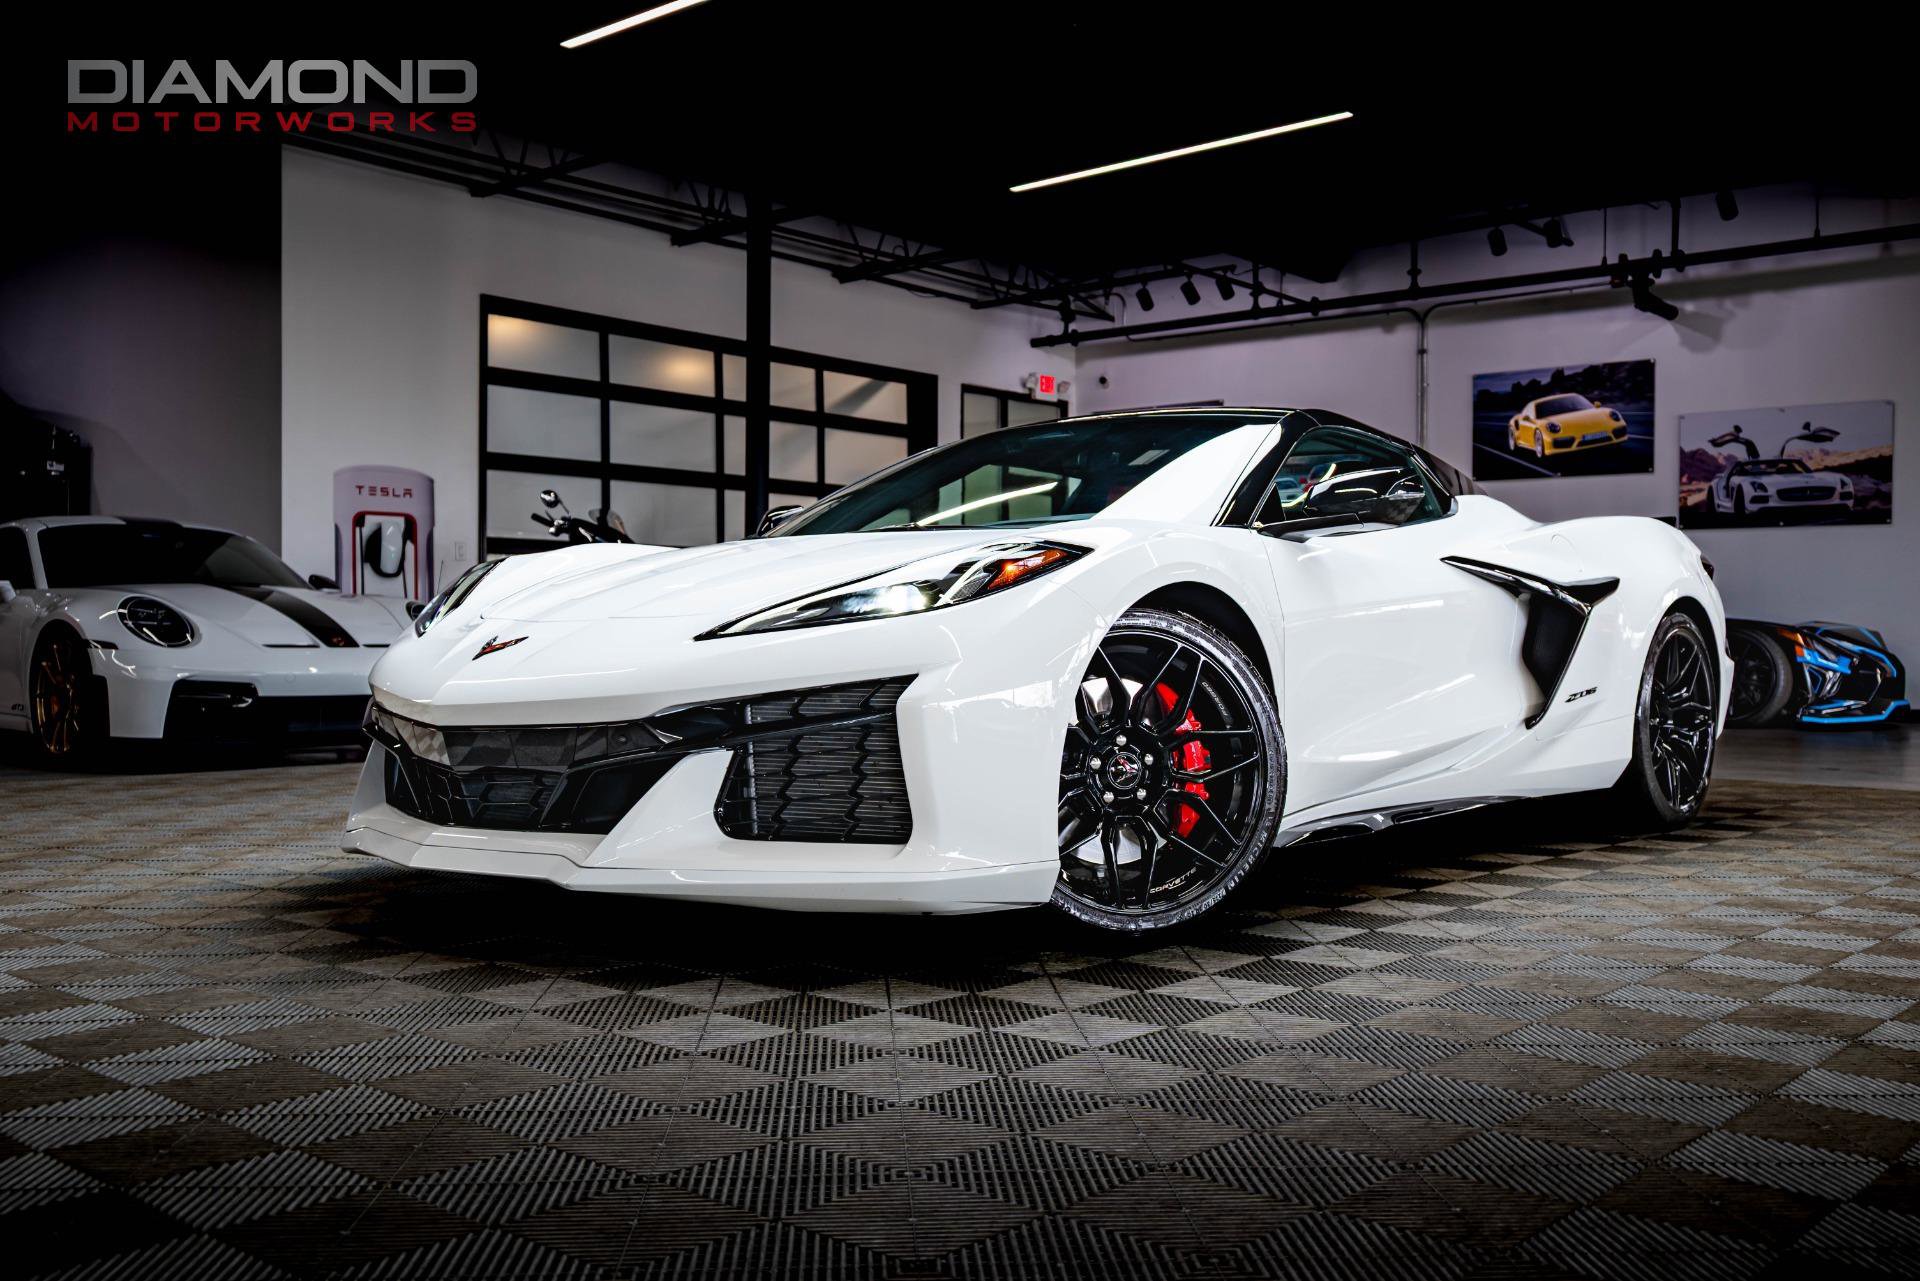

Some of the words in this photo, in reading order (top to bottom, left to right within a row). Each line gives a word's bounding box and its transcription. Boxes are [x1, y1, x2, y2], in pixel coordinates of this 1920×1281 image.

[355, 485, 413, 498] TESLA
[1227, 830, 1268, 891] MICHELIN
[1149, 866, 1197, 894] CORVETTE
